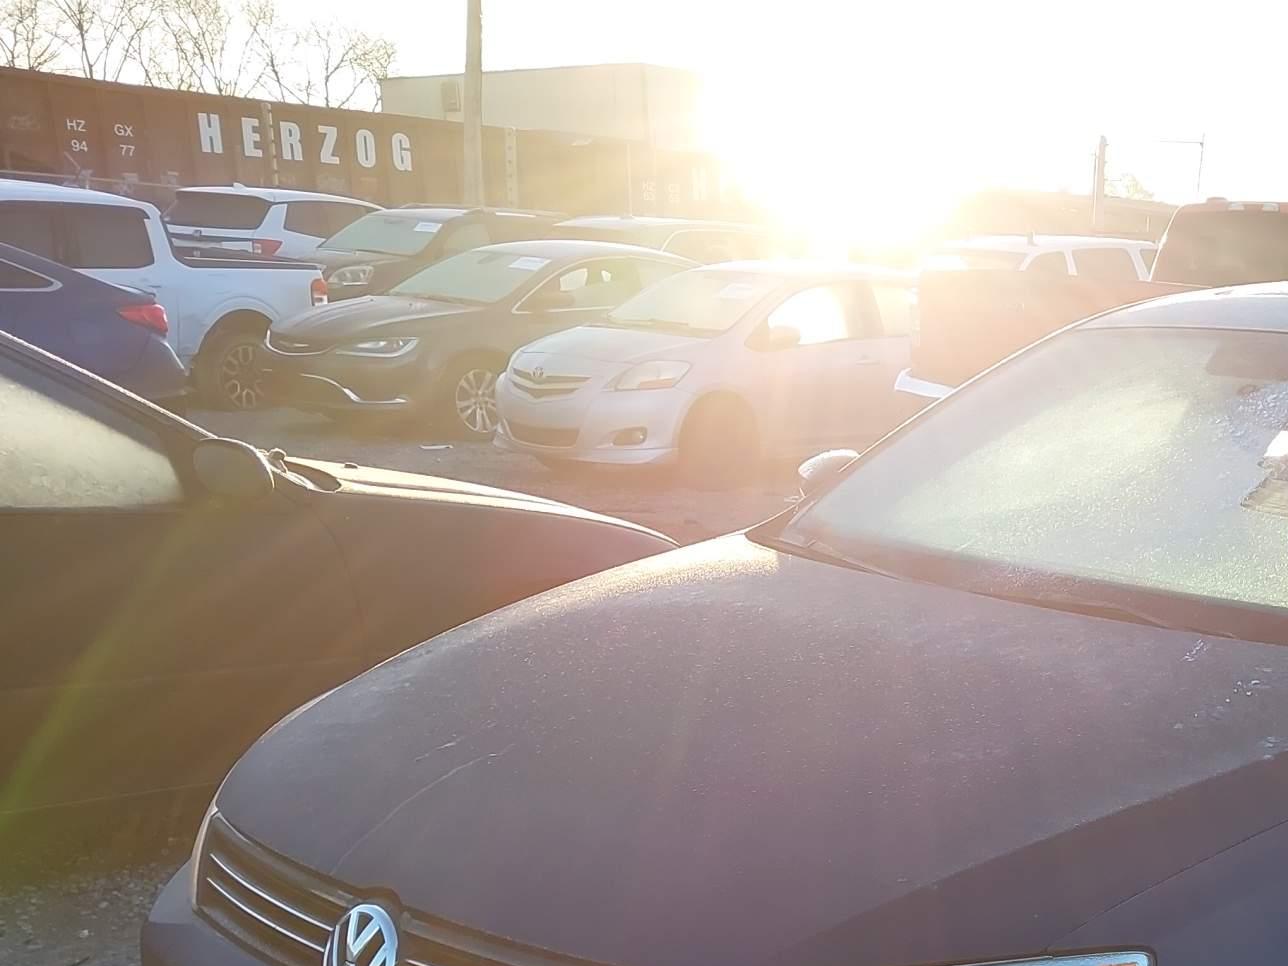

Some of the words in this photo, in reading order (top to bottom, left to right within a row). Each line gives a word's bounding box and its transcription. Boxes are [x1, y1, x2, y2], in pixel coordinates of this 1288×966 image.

[66, 119, 87, 132] HZ
[114, 124, 134, 137] GX
[71, 140, 88, 152] 94
[120, 144, 136, 157] 77
[197, 112, 413, 172] HERZOG
